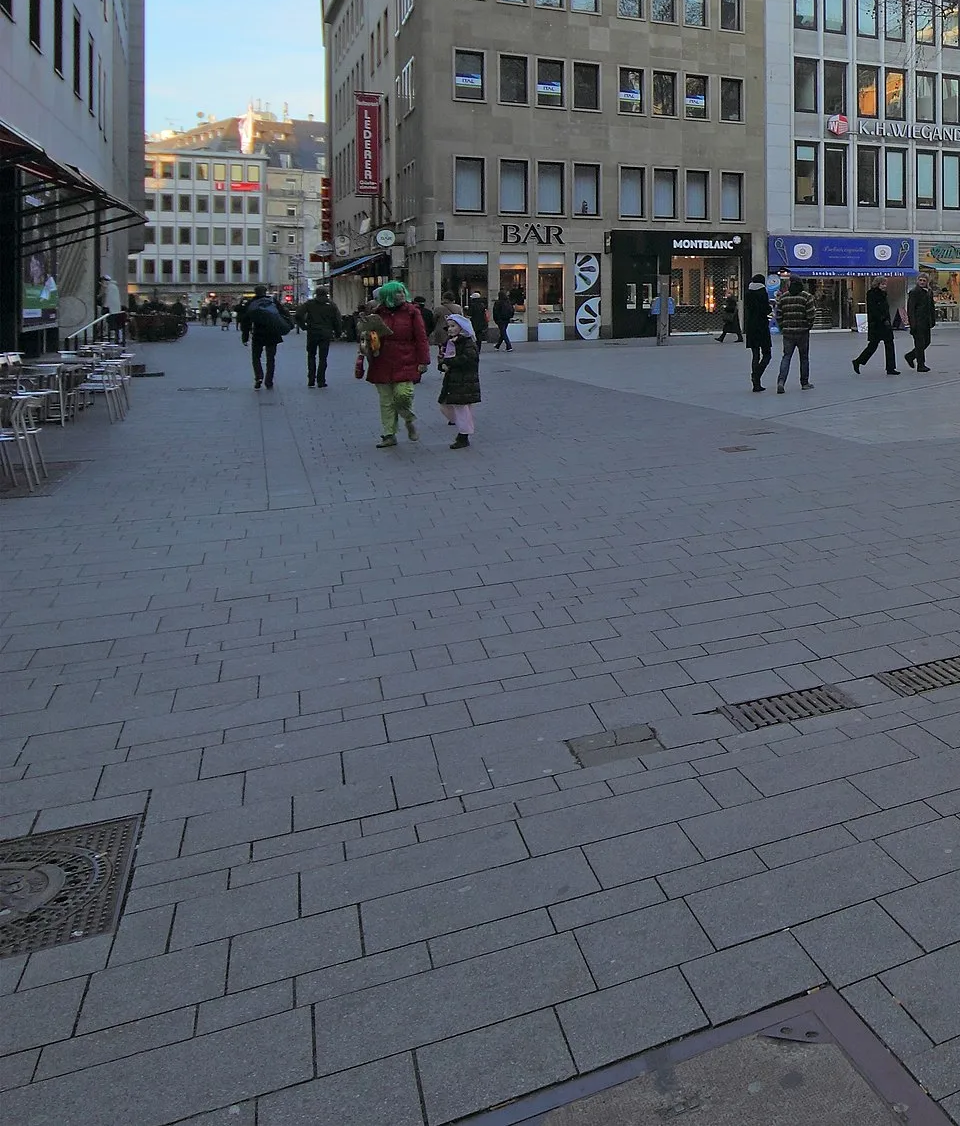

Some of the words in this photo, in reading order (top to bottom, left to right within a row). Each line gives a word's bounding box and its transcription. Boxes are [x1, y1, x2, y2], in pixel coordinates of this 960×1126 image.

[364, 109, 373, 180] LEDERER
[501, 222, 566, 245] BÄR
[672, 239, 734, 250] MONTBLANC
